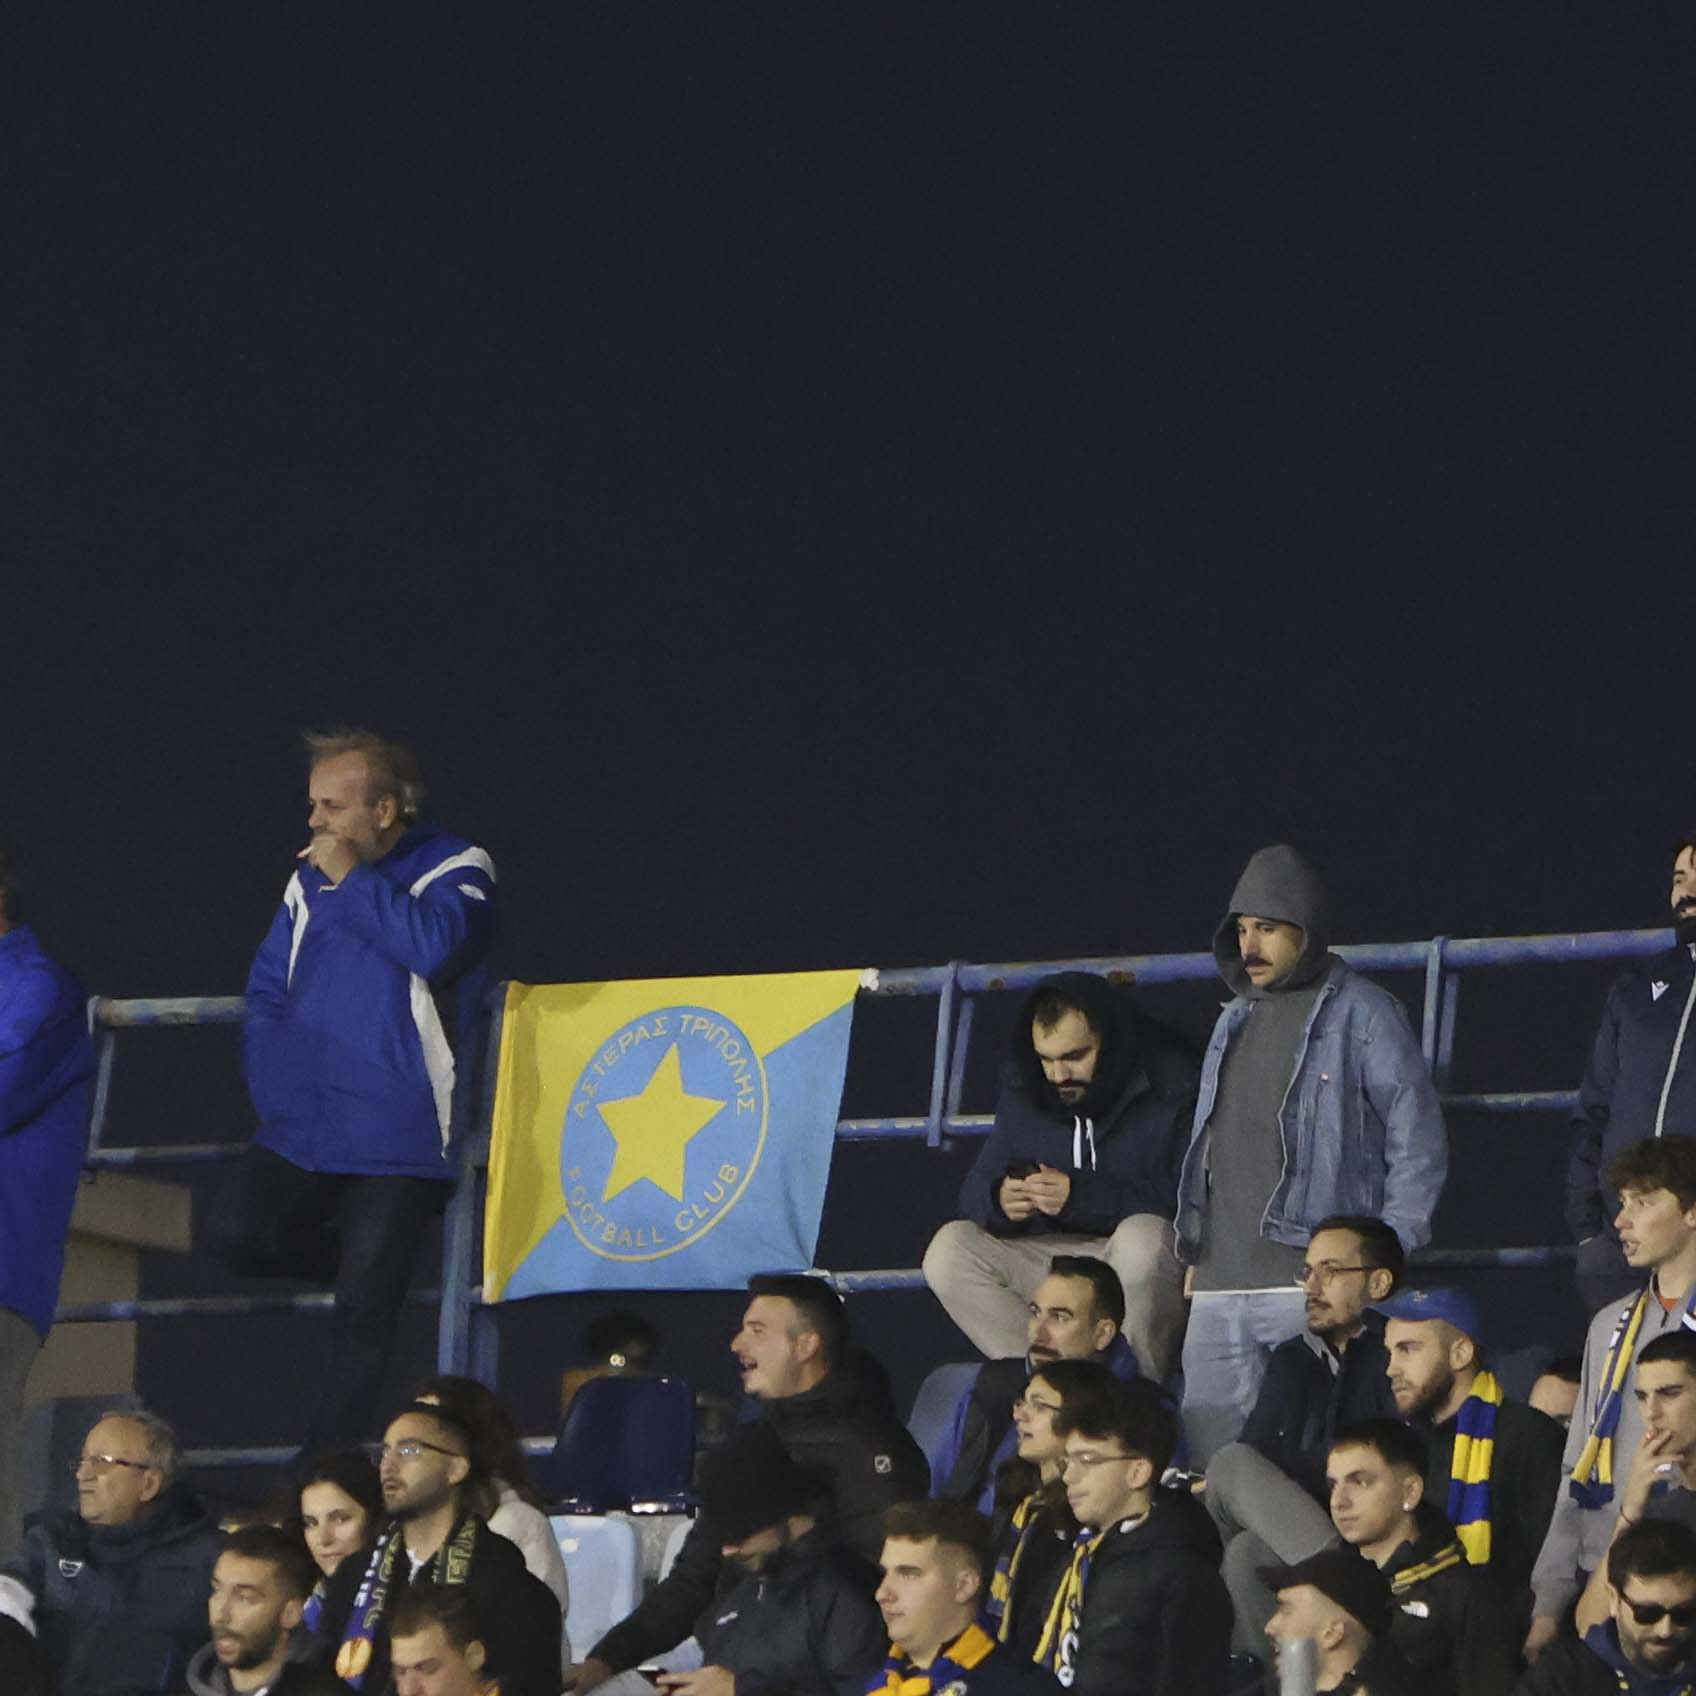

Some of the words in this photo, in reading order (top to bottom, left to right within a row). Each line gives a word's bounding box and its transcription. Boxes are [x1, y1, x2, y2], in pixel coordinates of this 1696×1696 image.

[573, 1014, 670, 1119] ΑΣΤΕΡΑΣ
[678, 1013, 756, 1116] ΤΡΙΠΟΛΗΣ
[568, 1165, 665, 1247] FOOTBALL
[674, 1162, 740, 1234] CLUB
